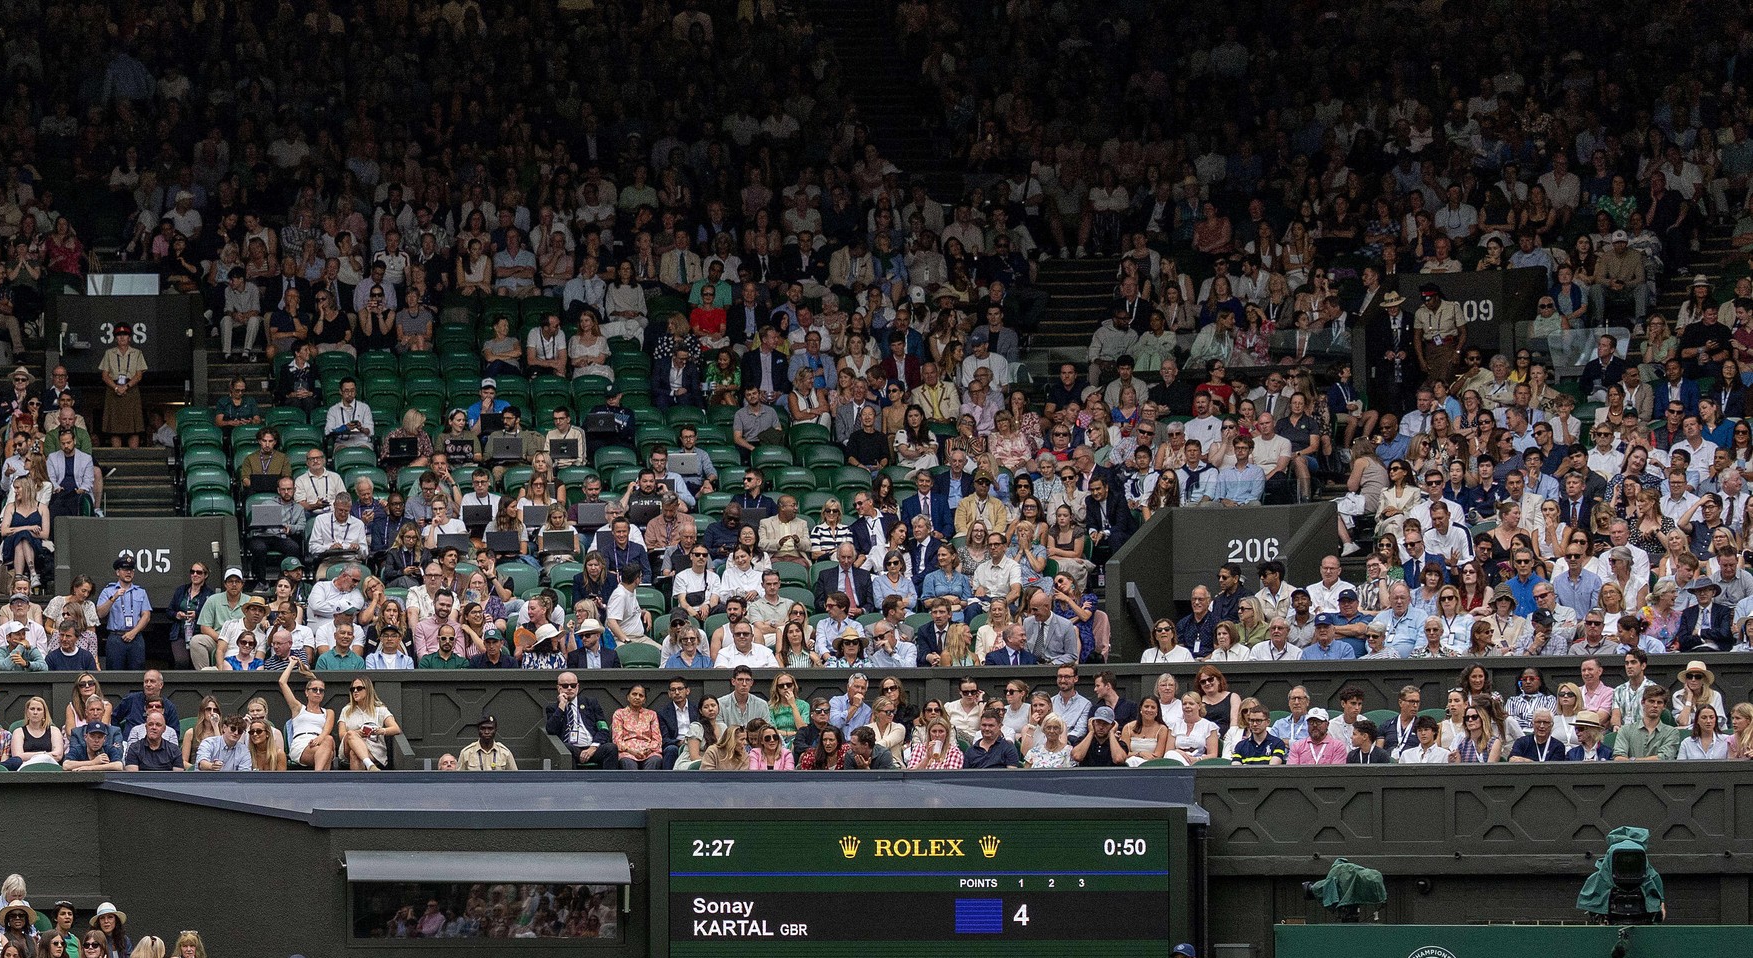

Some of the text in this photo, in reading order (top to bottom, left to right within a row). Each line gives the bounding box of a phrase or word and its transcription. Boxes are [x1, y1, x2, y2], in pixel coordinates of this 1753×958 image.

[1455, 299, 1494, 322] 09
[1227, 537, 1279, 563] 206
[692, 839, 735, 857] 2:27
[874, 839, 965, 857] ROLEX
[1104, 838, 1147, 857] 0:50
[959, 878, 1085, 888] POINTS 1 2 3
[692, 897, 754, 917] Sonay
[1013, 904, 1030, 926] 4
[693, 920, 808, 937] KARTAL GBR
